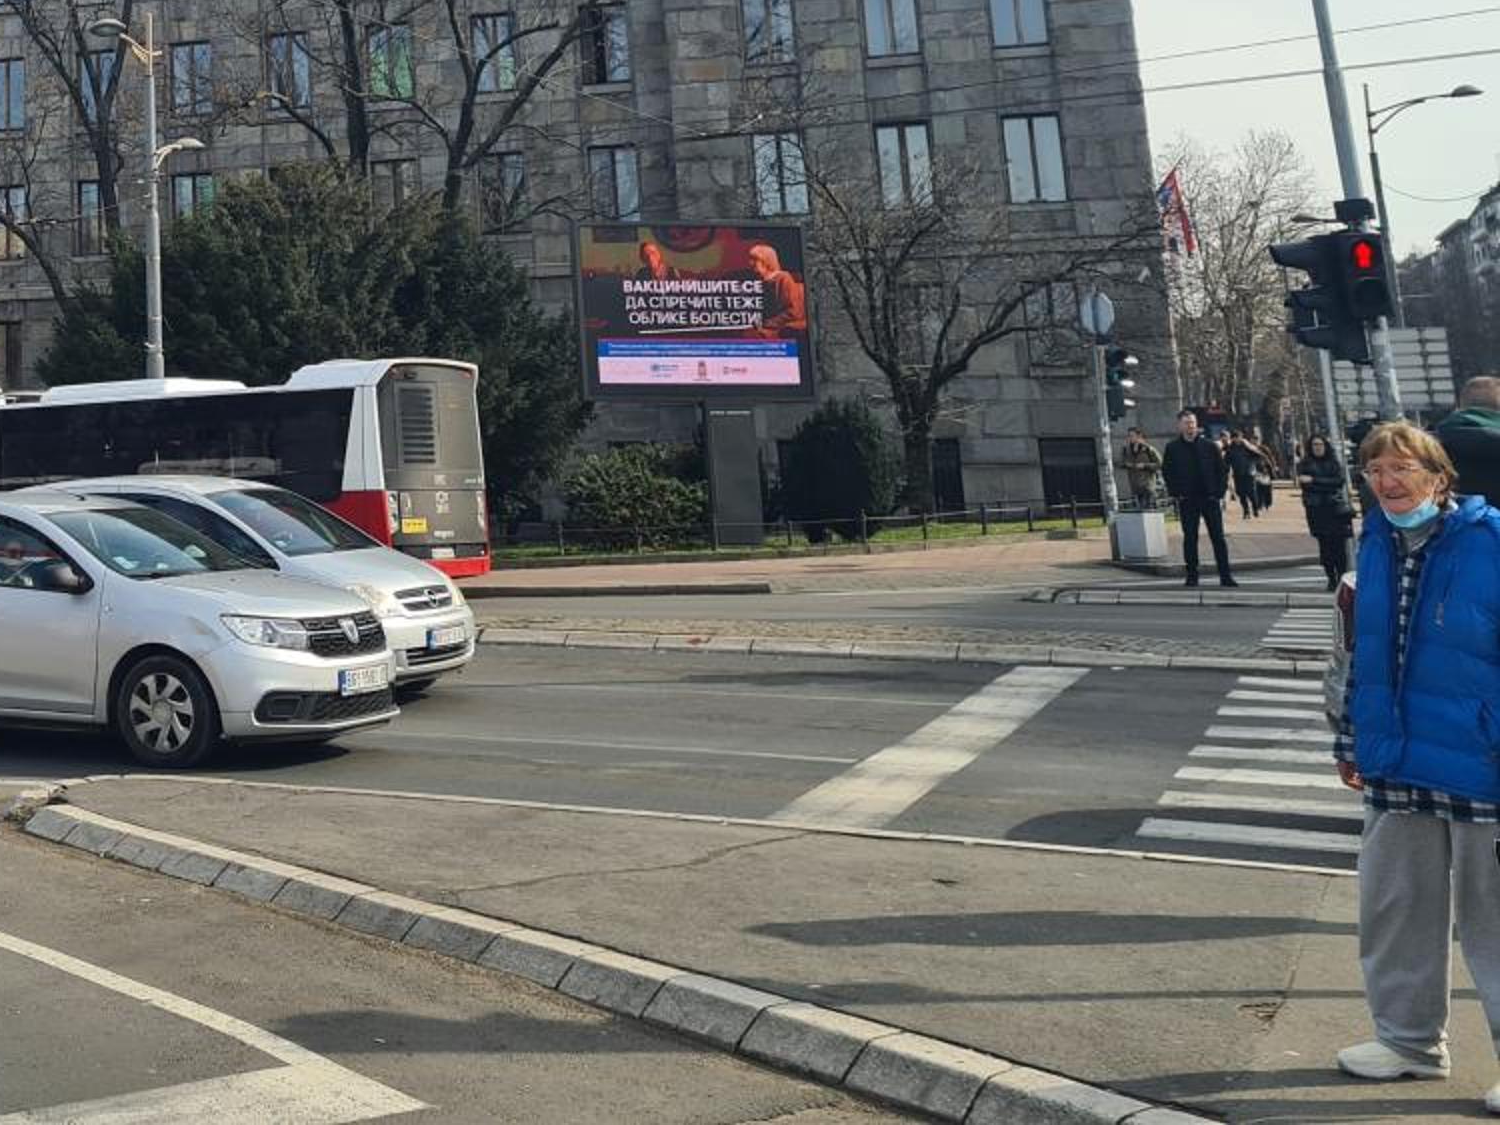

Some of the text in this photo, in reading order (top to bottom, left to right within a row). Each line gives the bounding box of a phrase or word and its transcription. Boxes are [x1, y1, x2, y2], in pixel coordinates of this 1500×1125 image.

[623, 280, 763, 294] ВАКЦИНИШИТЕ СЕ
[625, 296, 763, 309] ДА СПРЕЧИТЕ ТЕЖЕ
[629, 312, 763, 325] ОБЛИКЕ БОЛЕСТИ!
